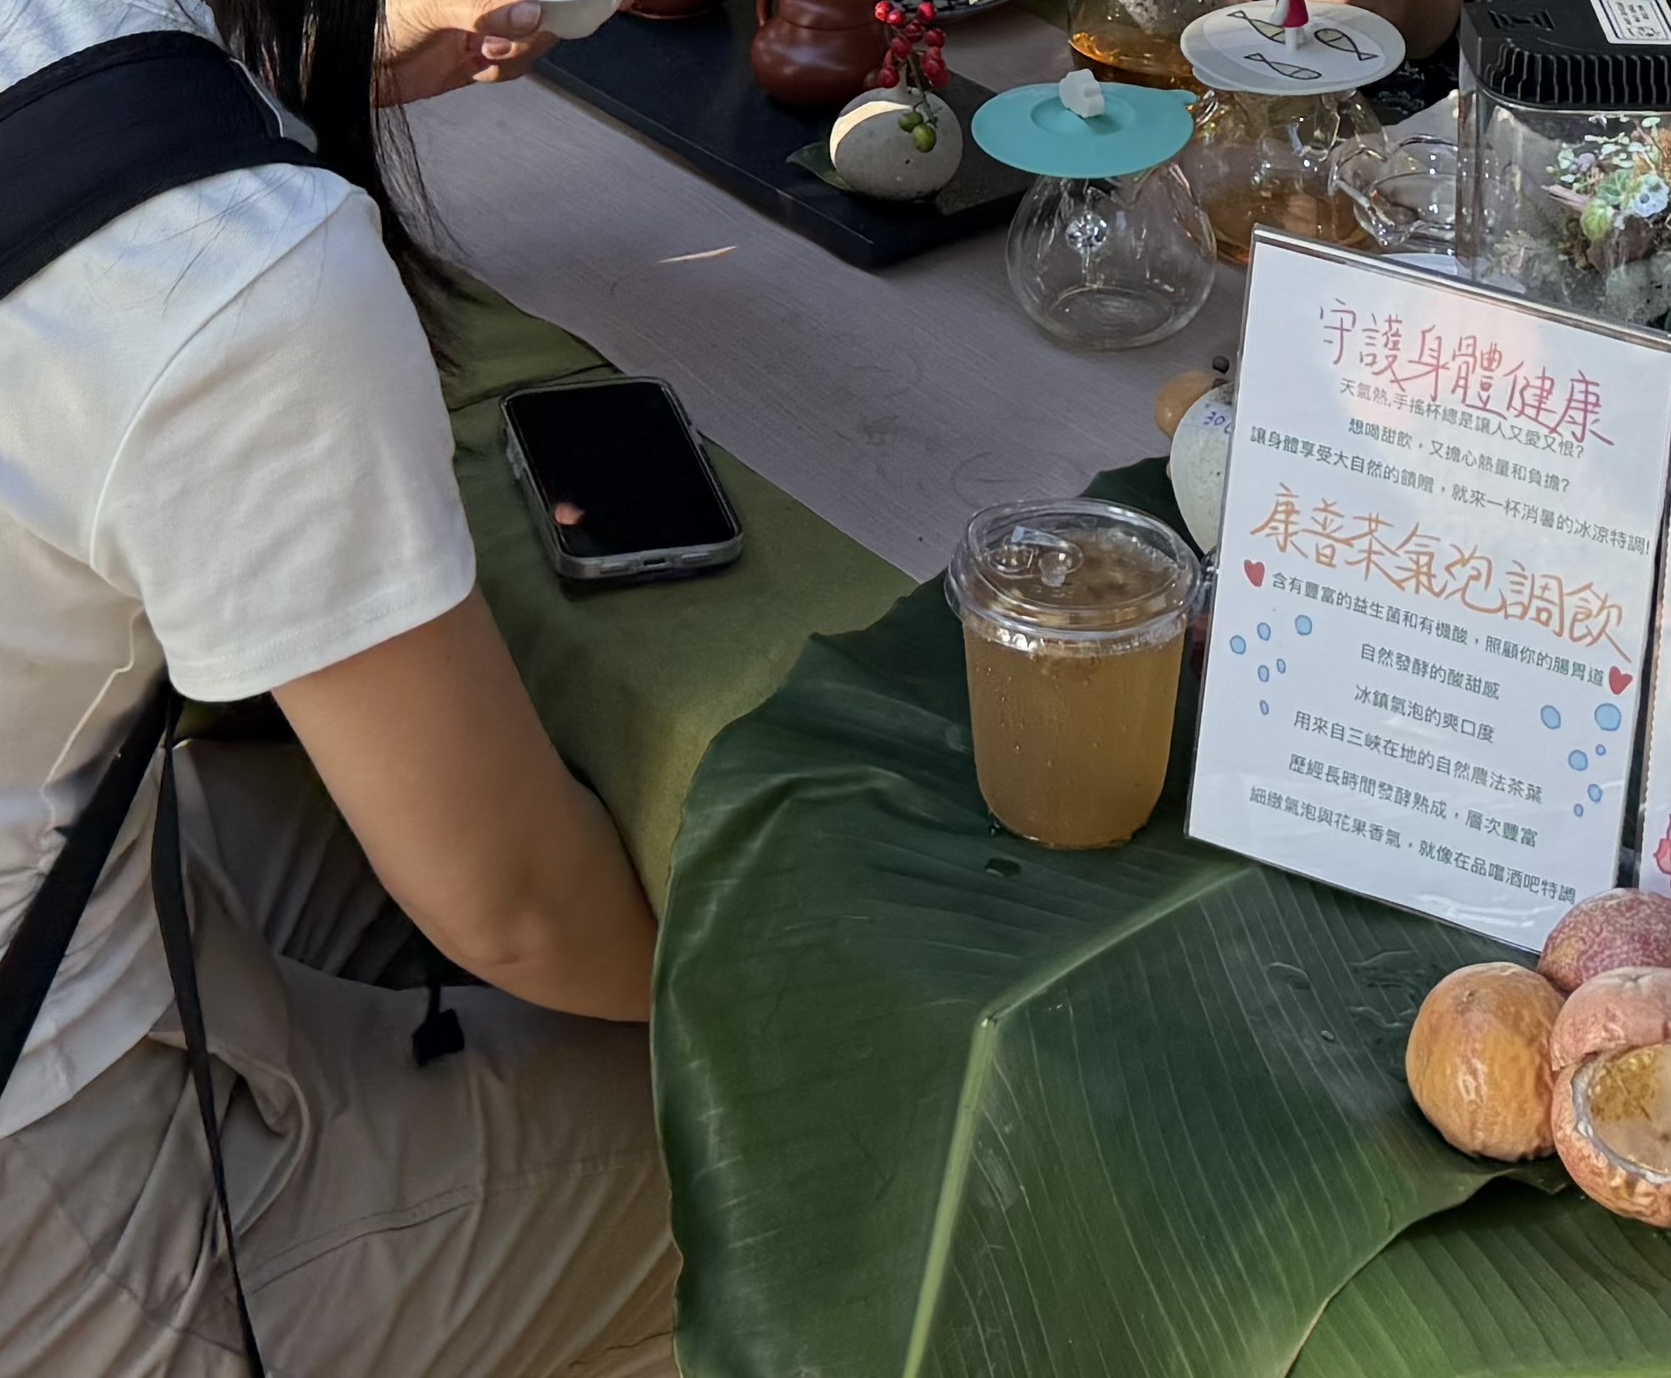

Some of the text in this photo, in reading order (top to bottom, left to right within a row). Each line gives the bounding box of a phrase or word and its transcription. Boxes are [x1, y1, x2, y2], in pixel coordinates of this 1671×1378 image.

[1318, 297, 1615, 446] 守護身體健康
[1249, 481, 1633, 664] 康普茶氣泡調飲
